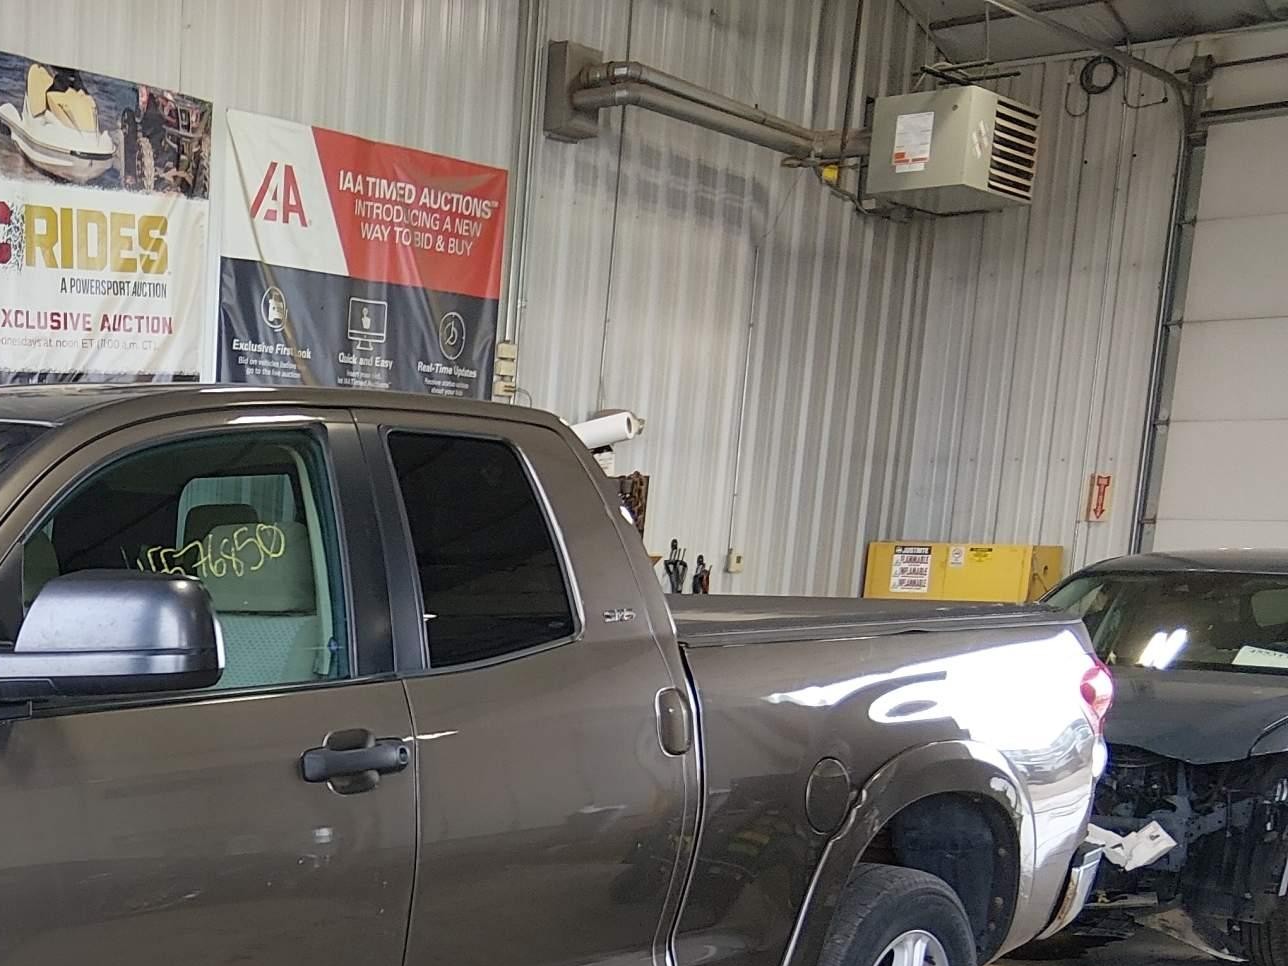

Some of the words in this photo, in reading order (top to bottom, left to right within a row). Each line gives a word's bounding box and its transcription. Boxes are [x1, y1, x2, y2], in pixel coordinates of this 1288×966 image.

[339, 169, 364, 195] IAA
[366, 176, 416, 204] TIMED
[354, 199, 440, 231] INTRODUCING
[442, 219, 452, 233] A
[454, 219, 482, 238] NEW
[24, 203, 170, 275] RIDES
[361, 221, 392, 241] WAY
[394, 226, 412, 246] TO
[414, 231, 433, 250] BID
[435, 236, 445, 252] &
[448, 237, 473, 257] BUY
[60, 277, 68, 294] A
[69, 277, 131, 297] POWERSPORT
[132, 280, 167, 299] AUCTION
[100, 314, 173, 335] AUCTION
[81, 338, 96, 350] ET
[232, 338, 274, 354] Exclusive
[338, 352, 358, 365] Quick
[359, 355, 374, 367] and
[374, 356, 393, 371] Easy
[417, 360, 453, 375] Real-Time
[453, 364, 477, 378] Updates
